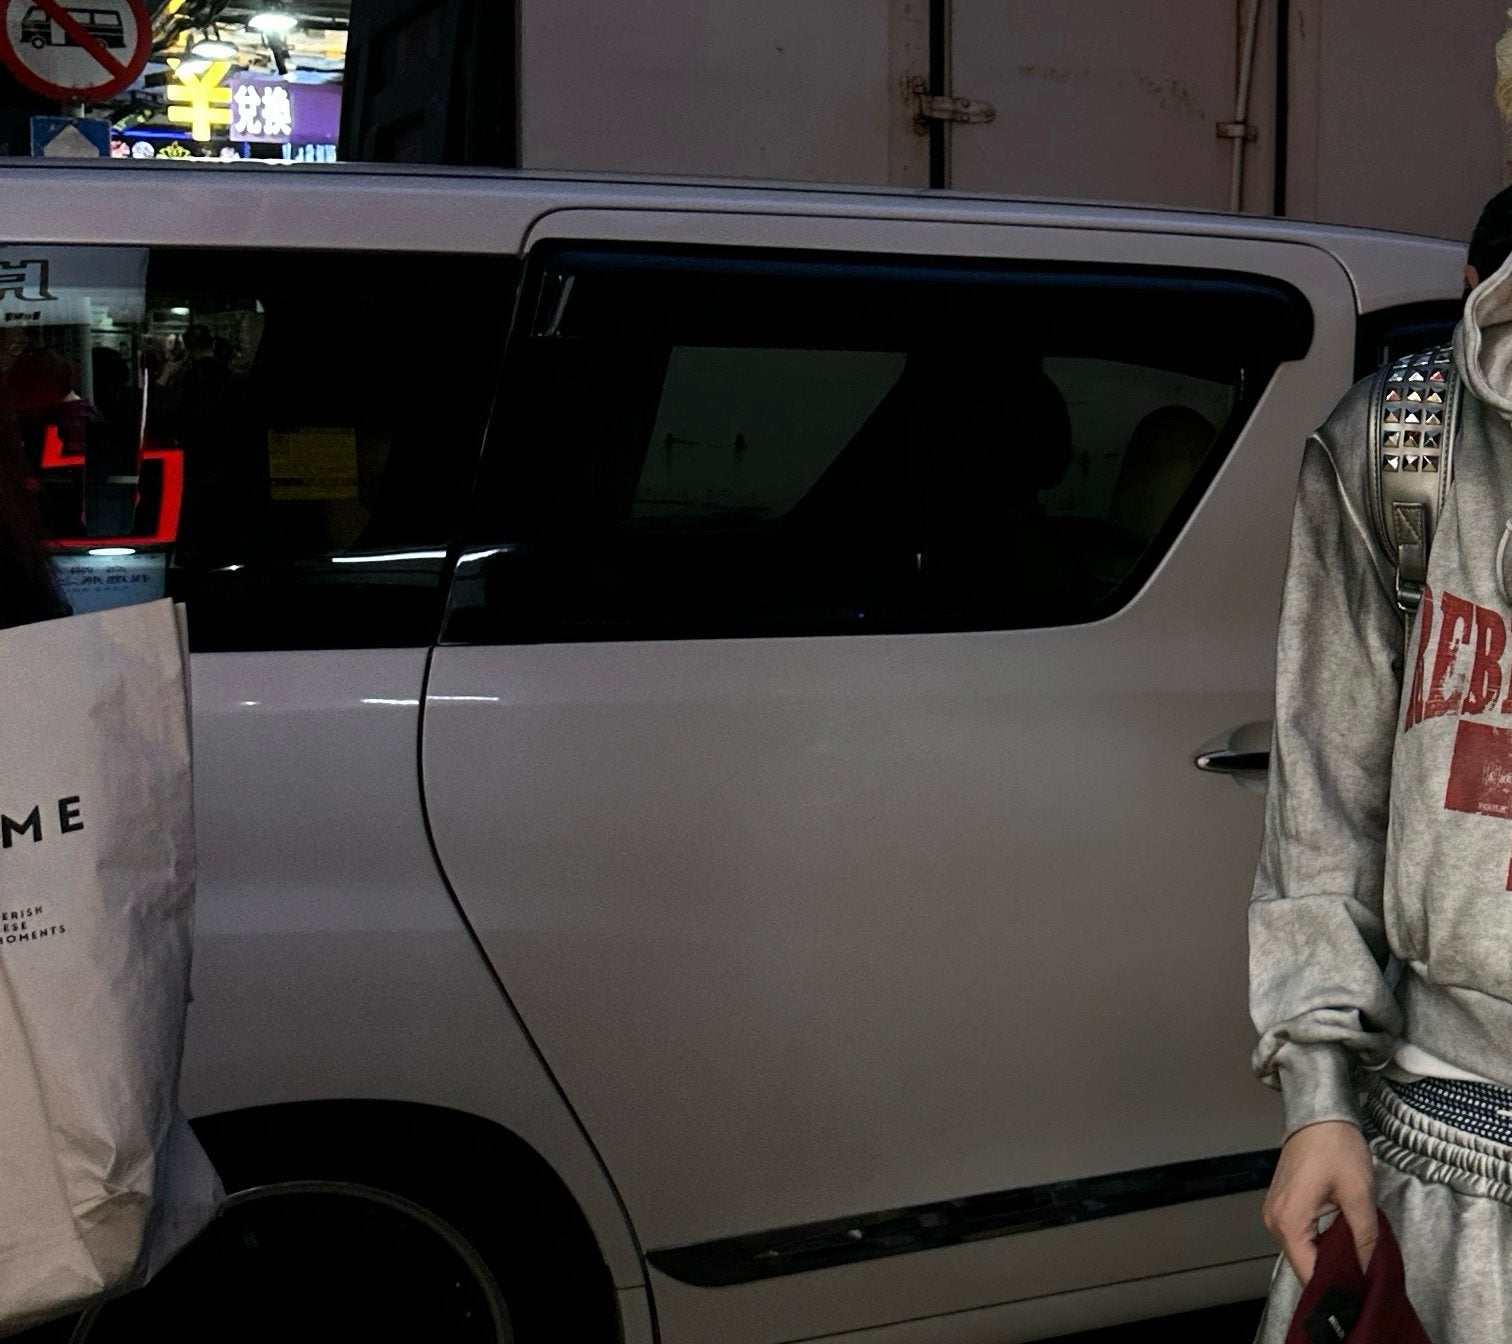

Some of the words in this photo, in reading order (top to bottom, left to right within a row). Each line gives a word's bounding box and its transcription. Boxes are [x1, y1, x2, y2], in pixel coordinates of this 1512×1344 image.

[1, 795, 85, 849] ME
[2, 906, 43, 921] ERISH
[3, 921, 28, 933] ESE
